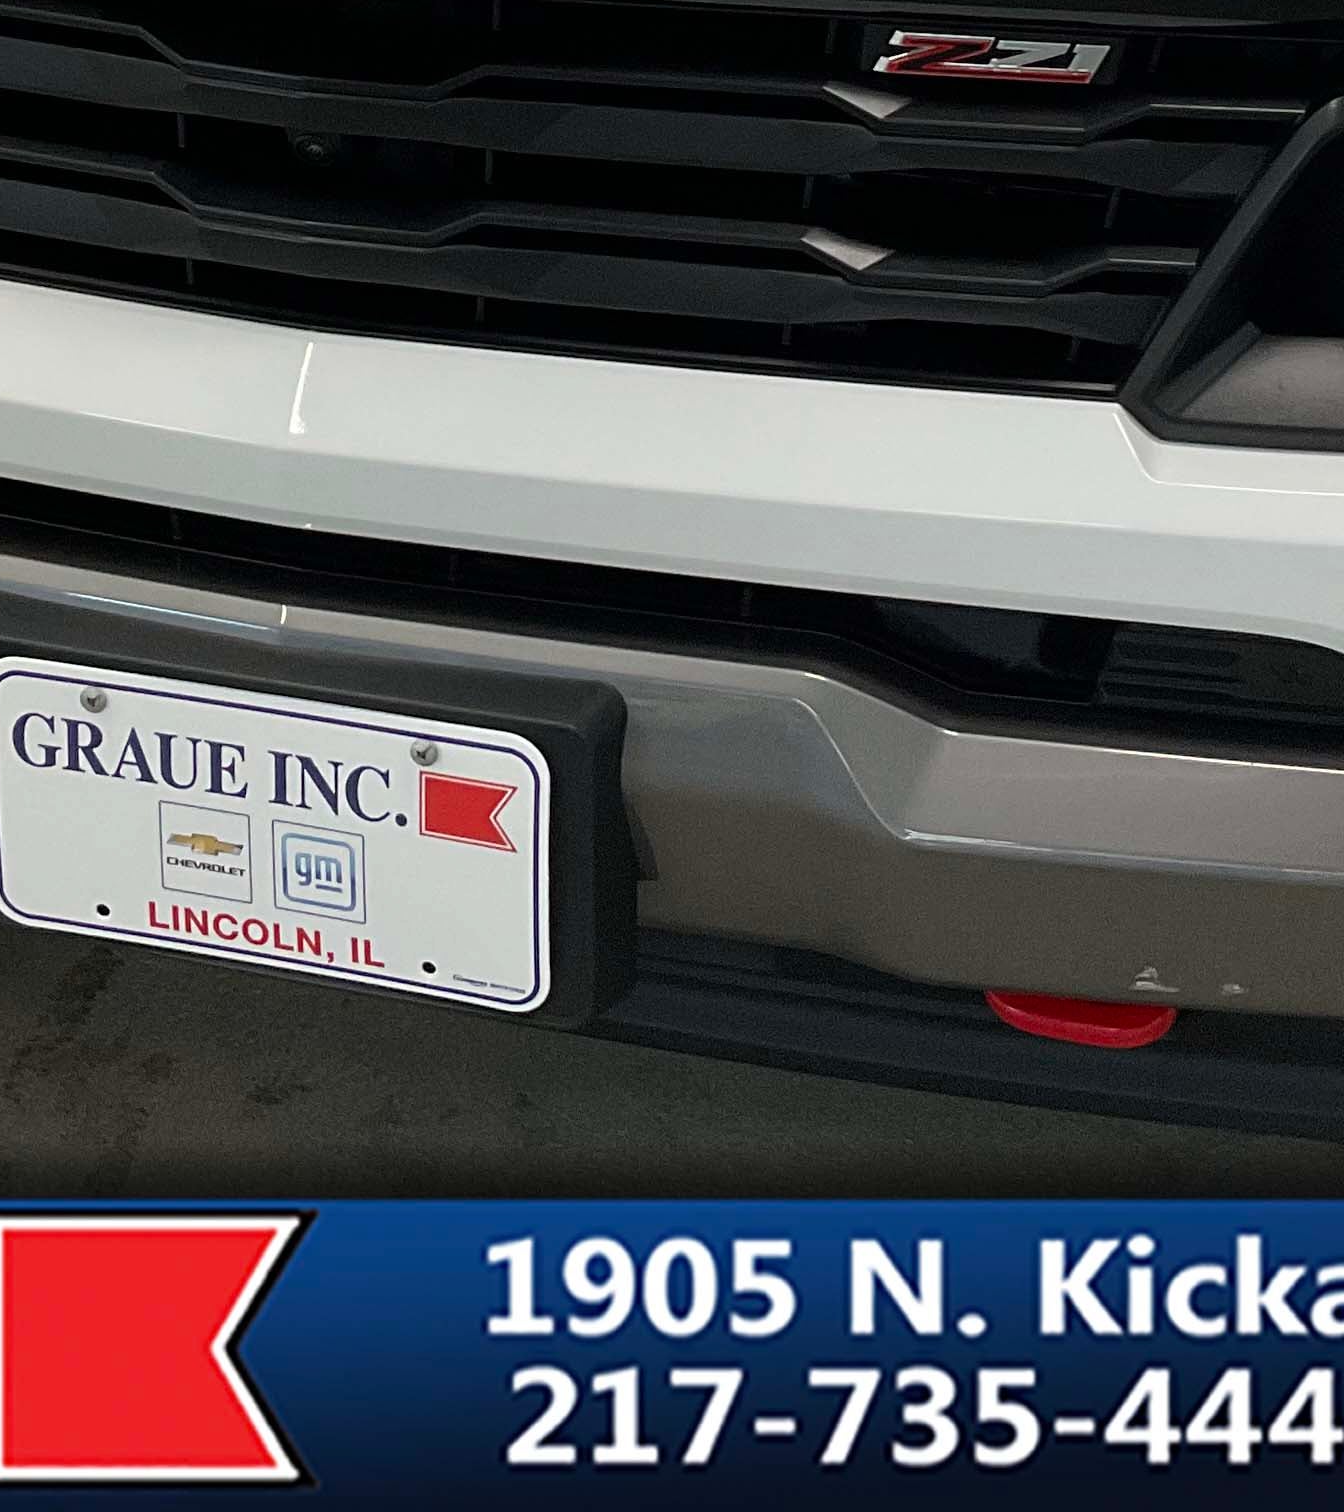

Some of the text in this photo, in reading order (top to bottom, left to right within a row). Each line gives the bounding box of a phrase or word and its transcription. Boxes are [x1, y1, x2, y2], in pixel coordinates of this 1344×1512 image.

[873, 30, 1111, 85] Z71
[11, 711, 409, 828] GRAUE INC.
[166, 856, 246, 878] CHEVROLET
[147, 900, 386, 969] LINCOLN, IL
